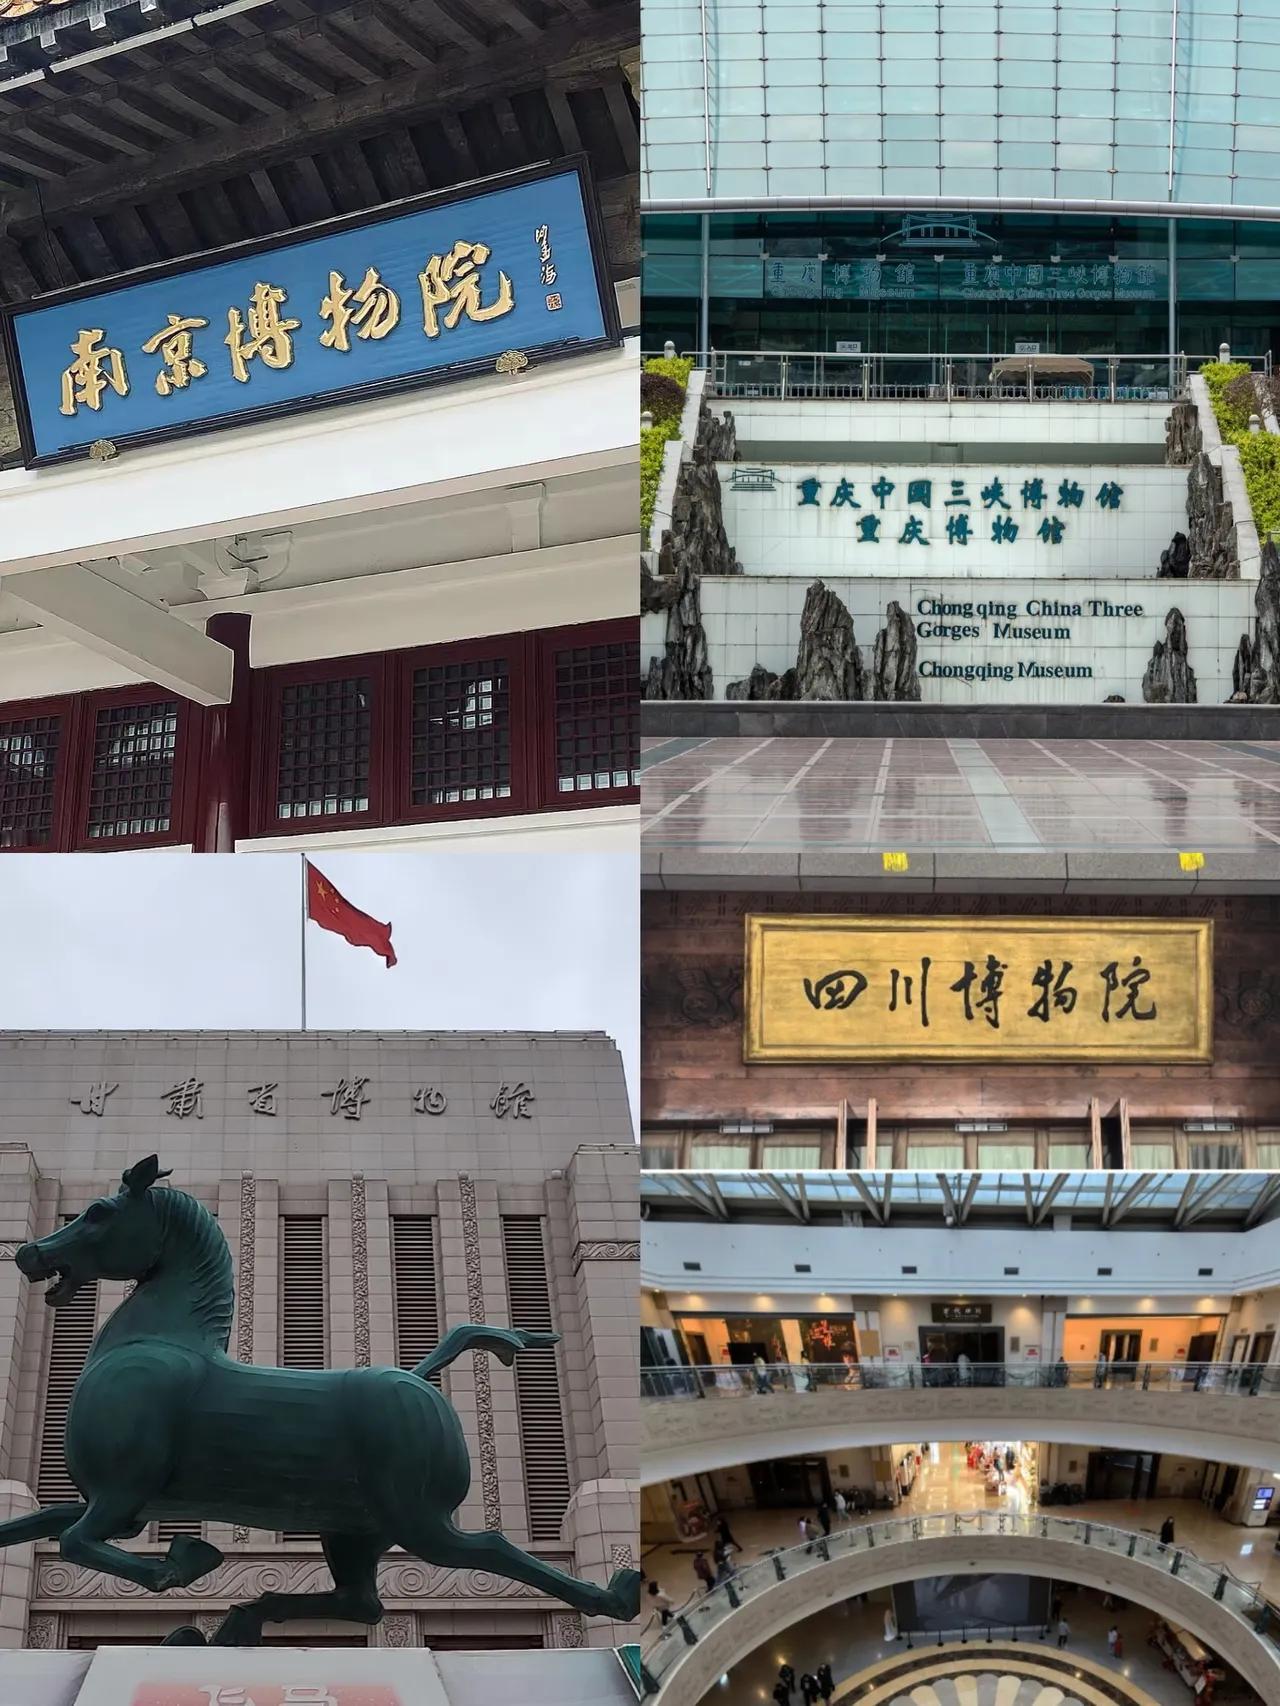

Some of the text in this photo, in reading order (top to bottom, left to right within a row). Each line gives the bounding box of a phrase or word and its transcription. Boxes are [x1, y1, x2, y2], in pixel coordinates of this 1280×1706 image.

[59, 240, 516, 417] 南京博物院
[856, 513, 1066, 546] 重庆博物馆
[917, 599, 1144, 619] Chongqing China Three
[917, 621, 1071, 641] Gorges Museum
[918, 660, 1093, 681] Chongqing Museum
[803, 955, 1157, 1028] 四川博物院
